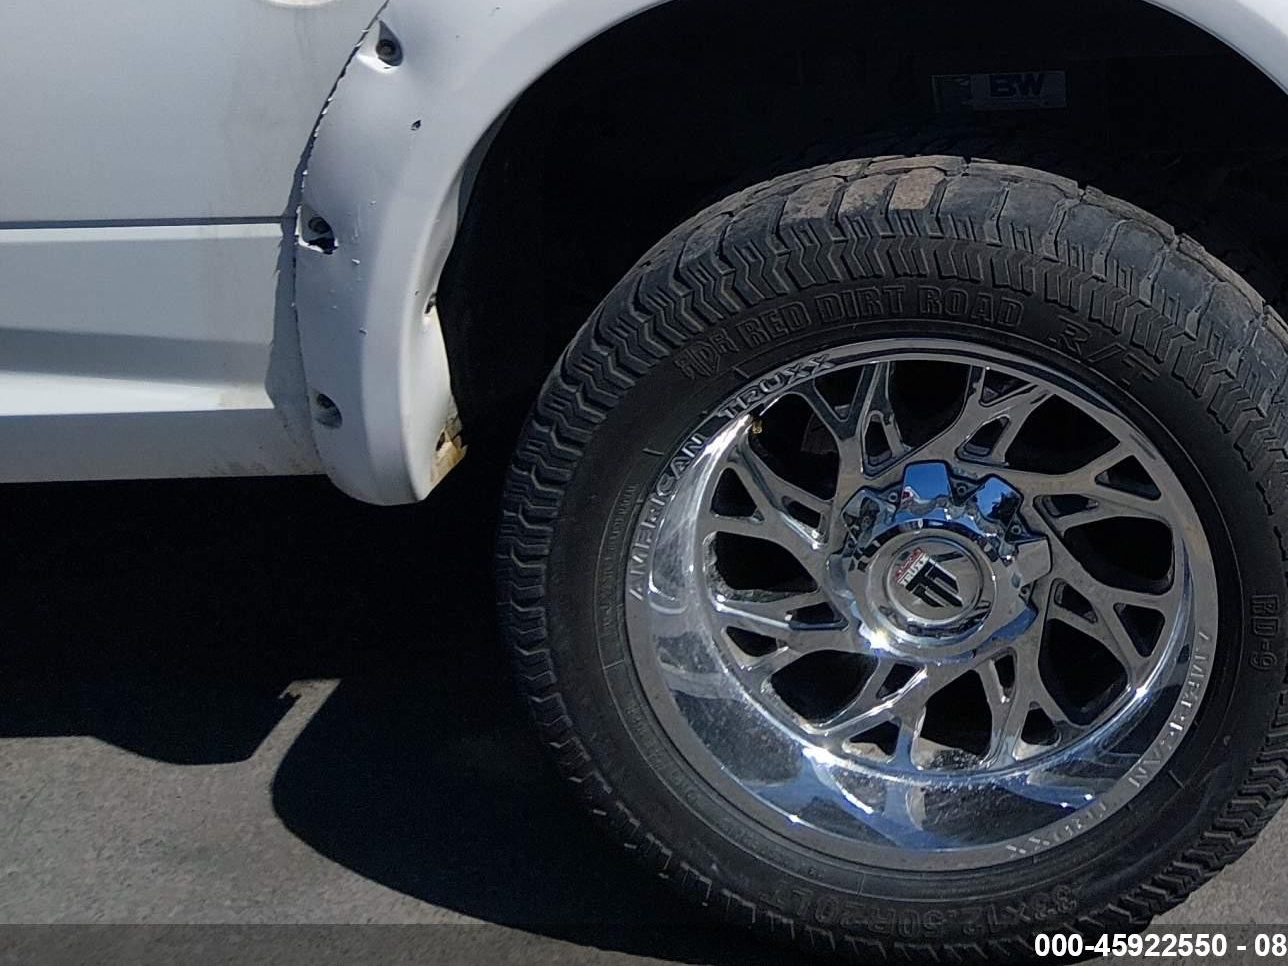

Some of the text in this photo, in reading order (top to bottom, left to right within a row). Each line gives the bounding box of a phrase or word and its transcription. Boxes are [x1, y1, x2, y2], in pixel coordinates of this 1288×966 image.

[734, 300, 812, 347] RED
[814, 284, 905, 325] DIRT
[918, 285, 1025, 328] ROAD
[628, 433, 710, 601] AMERICAN
[717, 353, 834, 419] TRUXX
